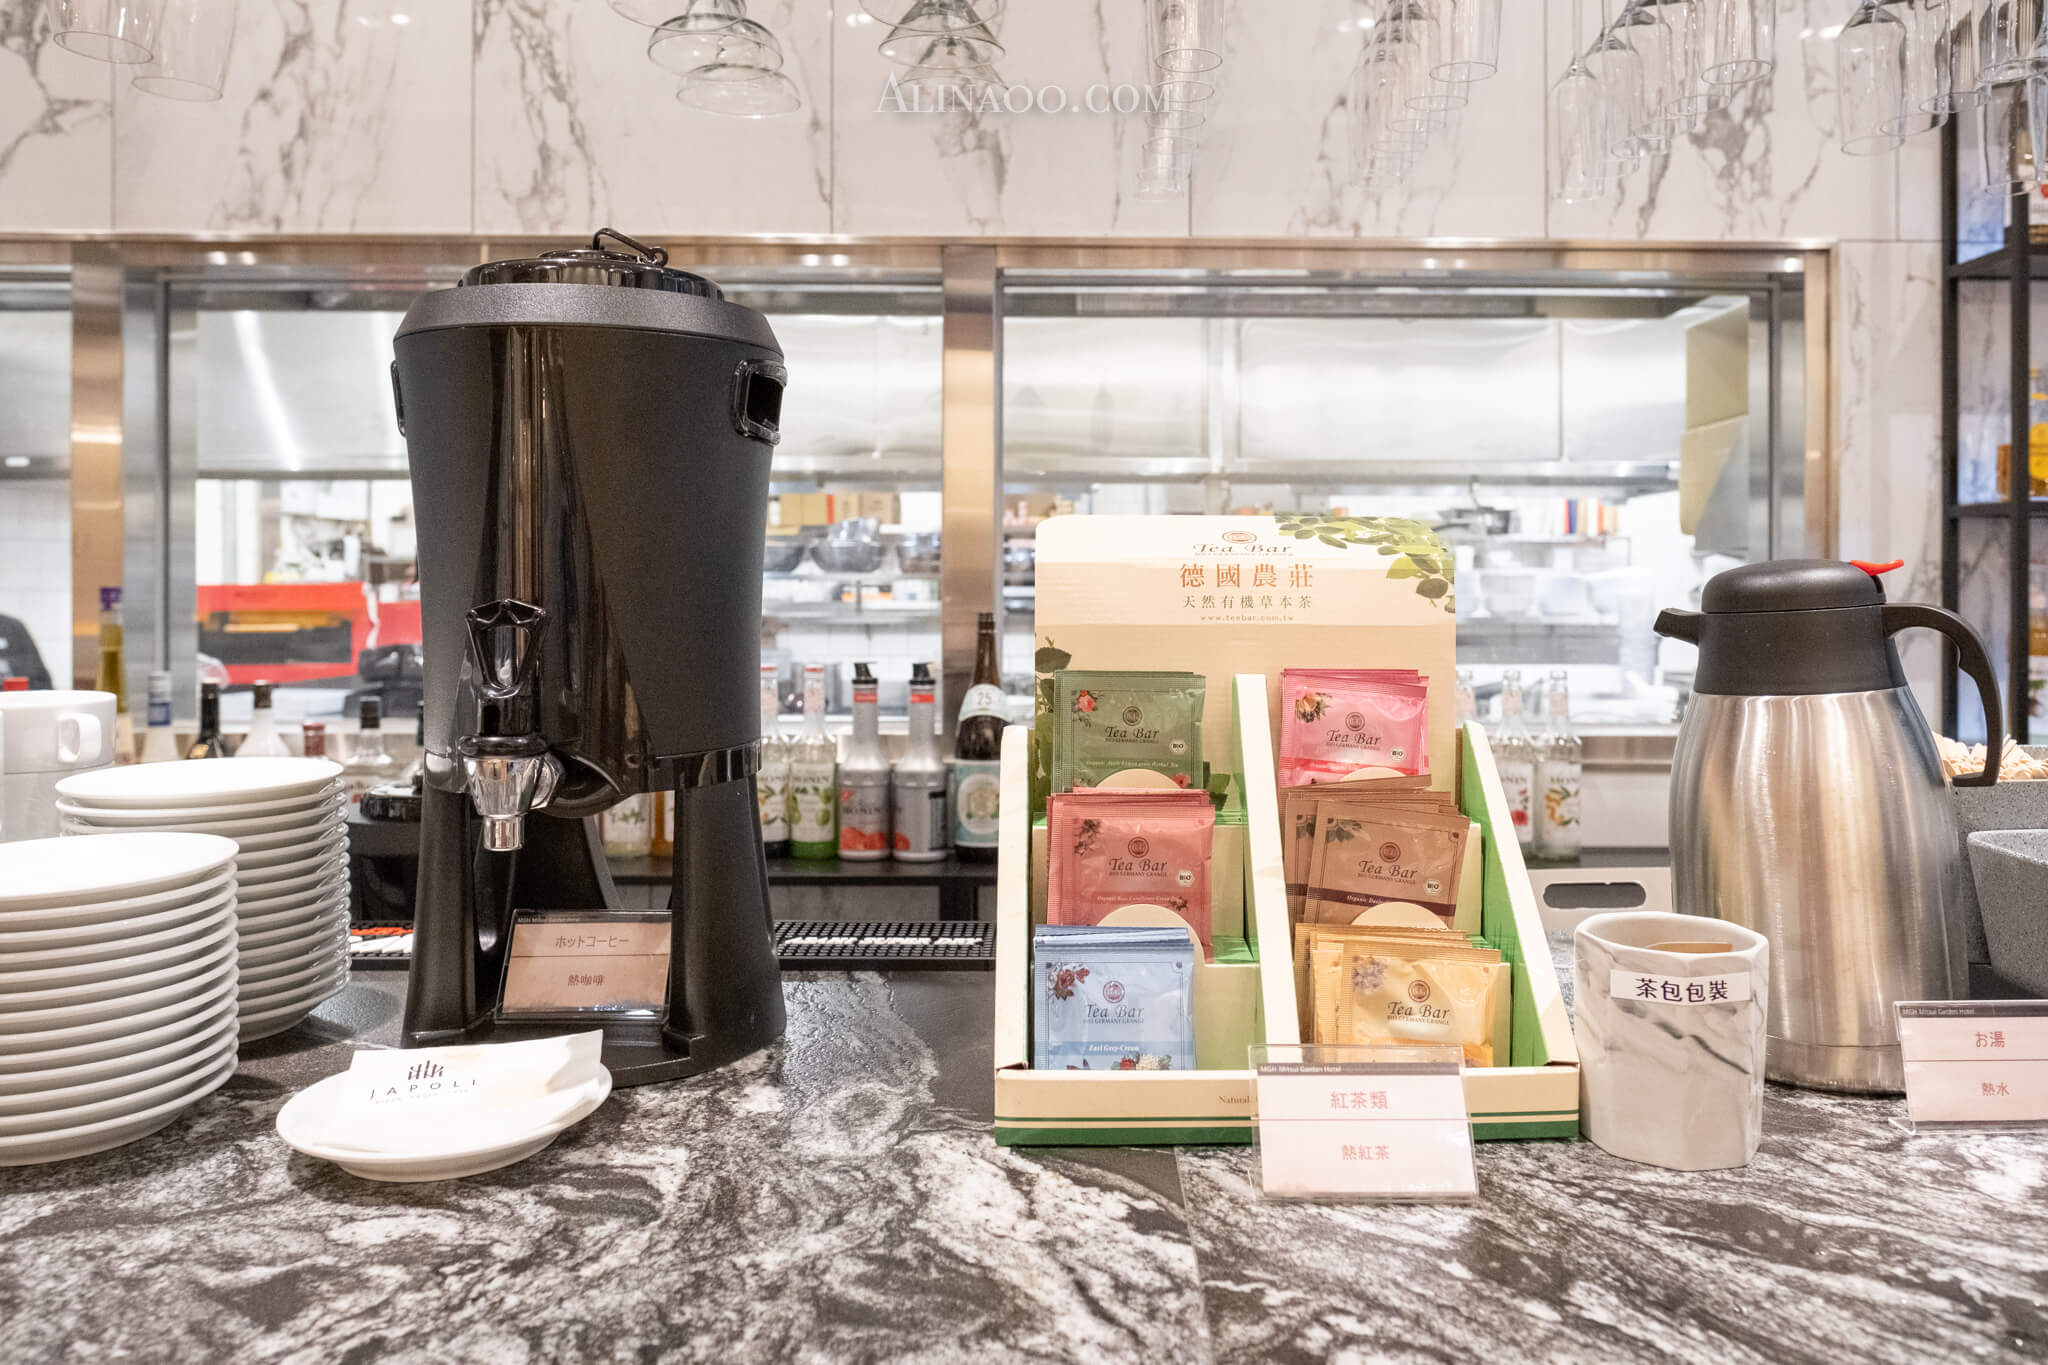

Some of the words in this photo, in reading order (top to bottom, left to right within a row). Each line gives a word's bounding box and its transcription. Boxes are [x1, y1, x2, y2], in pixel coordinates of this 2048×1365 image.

[1193, 543, 1233, 553] Tea
[1244, 543, 1293, 553] Bar
[1180, 563, 1313, 588] 德國農莊
[1182, 595, 1312, 609] 天然有機草本茶
[1105, 726, 1127, 738] Tea
[1133, 728, 1160, 739] Bar
[1327, 729, 1349, 742] Tea
[1354, 732, 1381, 745] Bar
[1108, 857, 1134, 871] Tea
[1139, 859, 1168, 872] Bar
[1358, 860, 1383, 874] Tea
[1389, 864, 1418, 879] Bar
[555, 935, 630, 949] ホットコーヒー
[567, 974, 606, 987] 熱咖啡
[1635, 977, 1729, 1003] 茶包包裝
[1087, 1003, 1108, 1018] Tea
[1114, 1005, 1145, 1018] Bar
[1387, 1001, 1413, 1016] Tea
[1418, 1004, 1450, 1019] Bar
[1975, 1031, 2006, 1048] お湯
[1981, 1081, 2010, 1097] 熱水
[1216, 1095, 1250, 1104] Natural
[1330, 1090, 1389, 1110] 紅茶類
[1341, 1145, 1390, 1160] 熱紅茶
